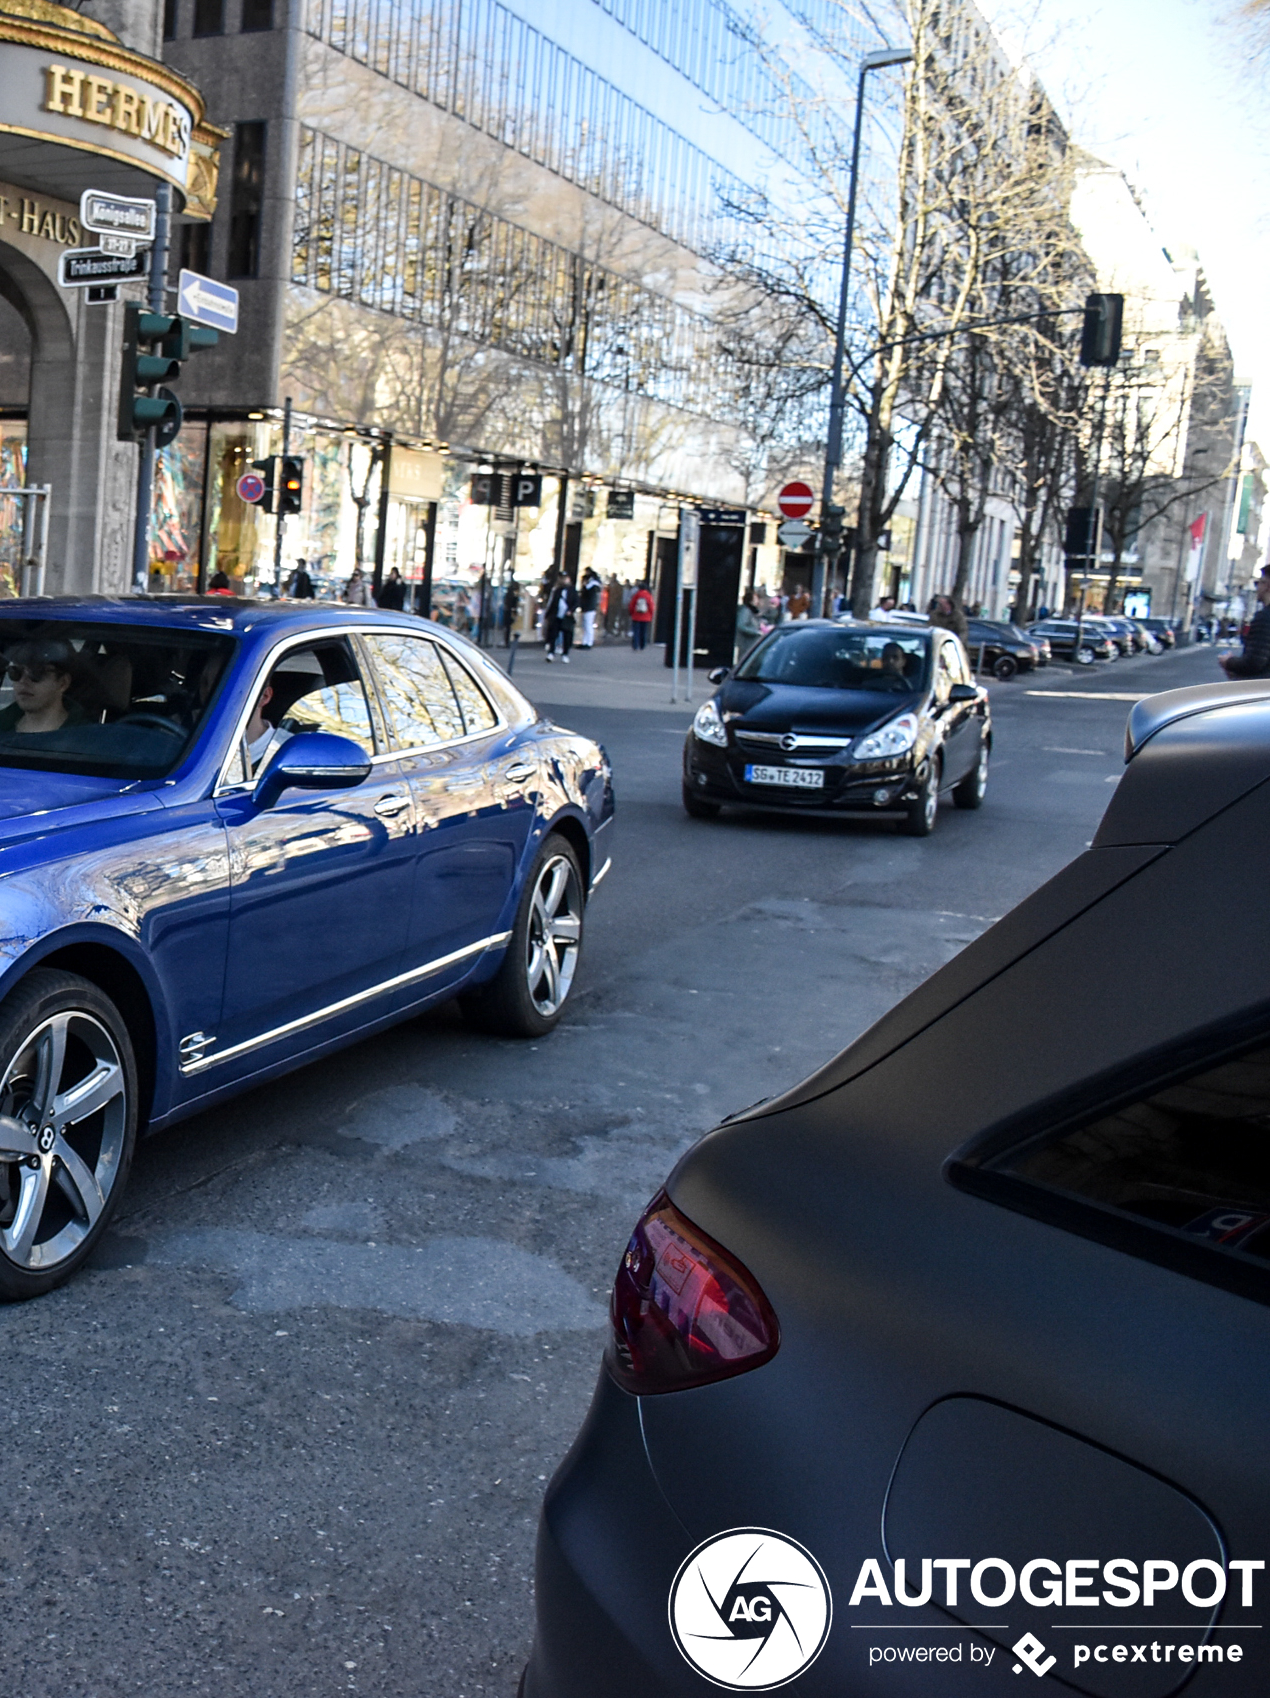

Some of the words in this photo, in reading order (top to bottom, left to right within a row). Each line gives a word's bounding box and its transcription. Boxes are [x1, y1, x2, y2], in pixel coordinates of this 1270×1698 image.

[517, 480, 536, 502] P
[753, 767, 768, 781] SG
[776, 769, 790, 783] TE
[792, 771, 822, 786] 2412
